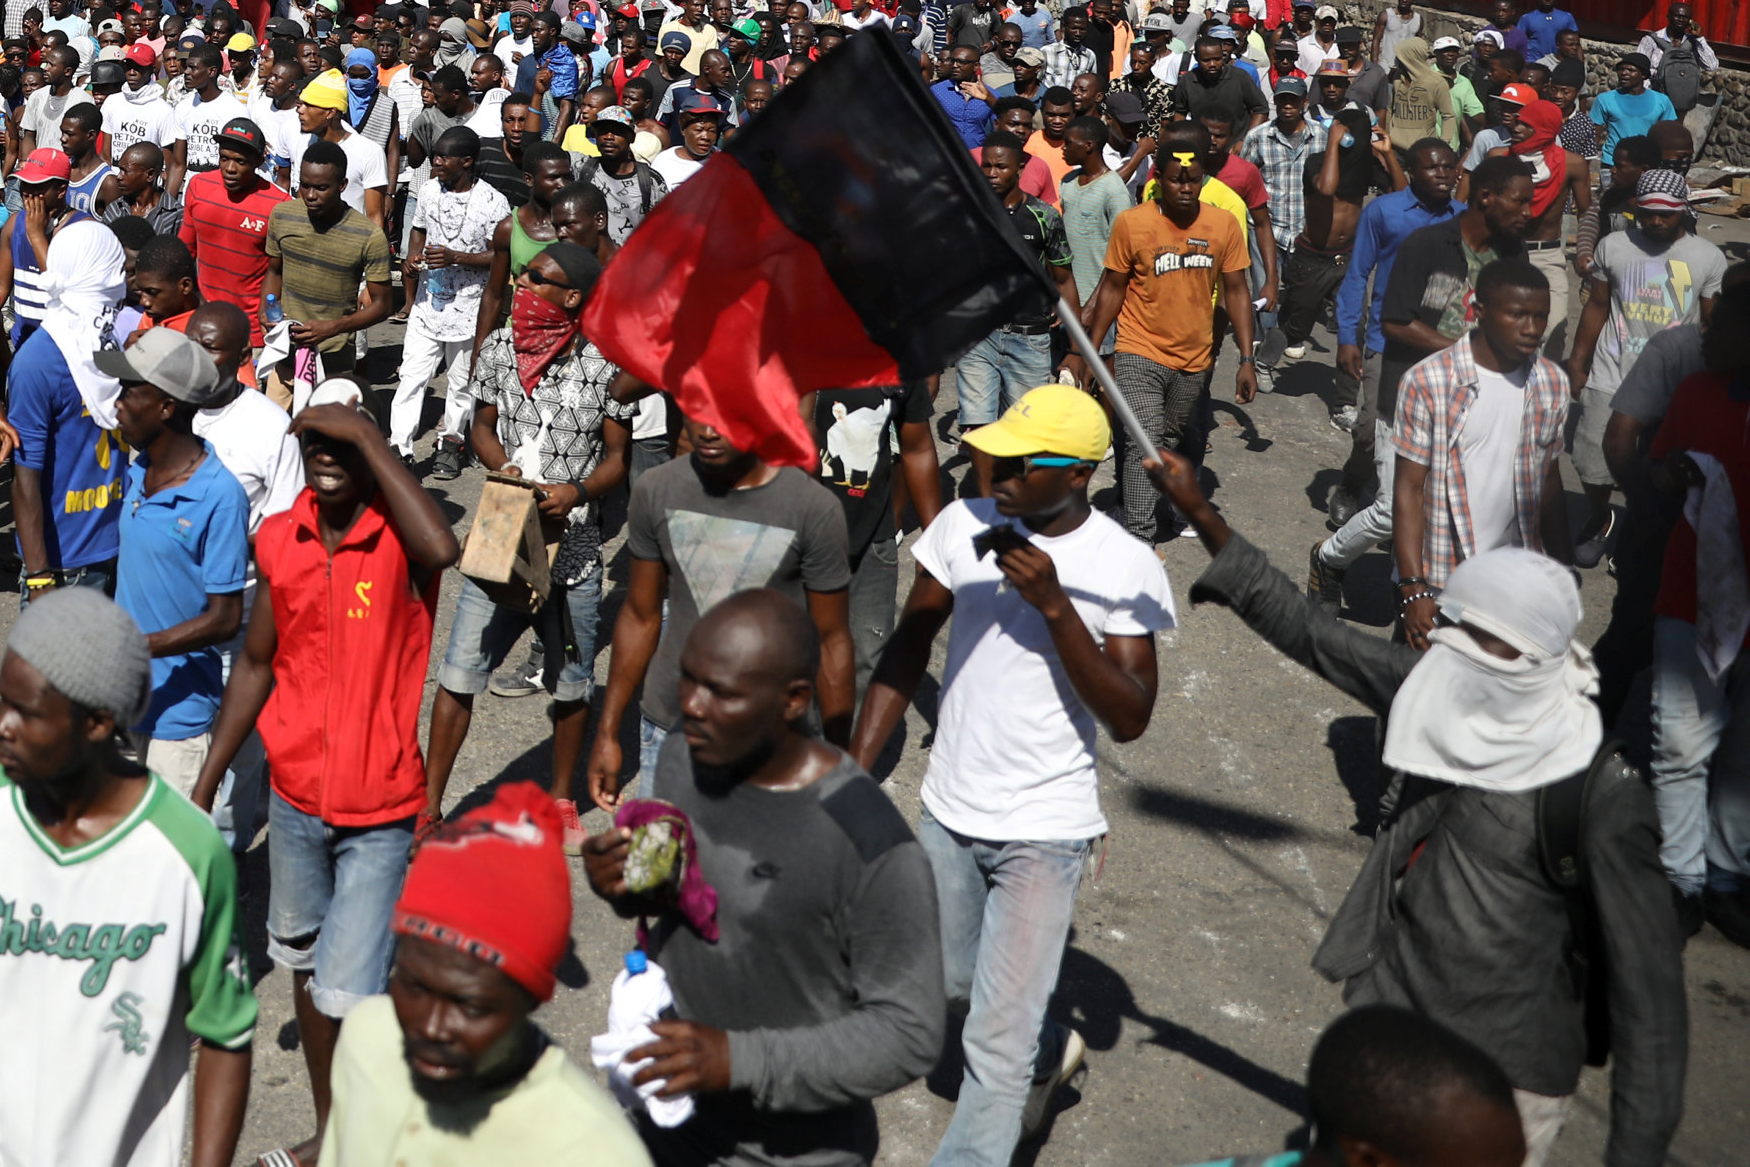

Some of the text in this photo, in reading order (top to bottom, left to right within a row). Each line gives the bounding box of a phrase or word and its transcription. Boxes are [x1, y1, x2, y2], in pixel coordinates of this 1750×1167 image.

[240, 217, 265, 232] A&F
[1155, 252, 1214, 276] HELL WEEK
